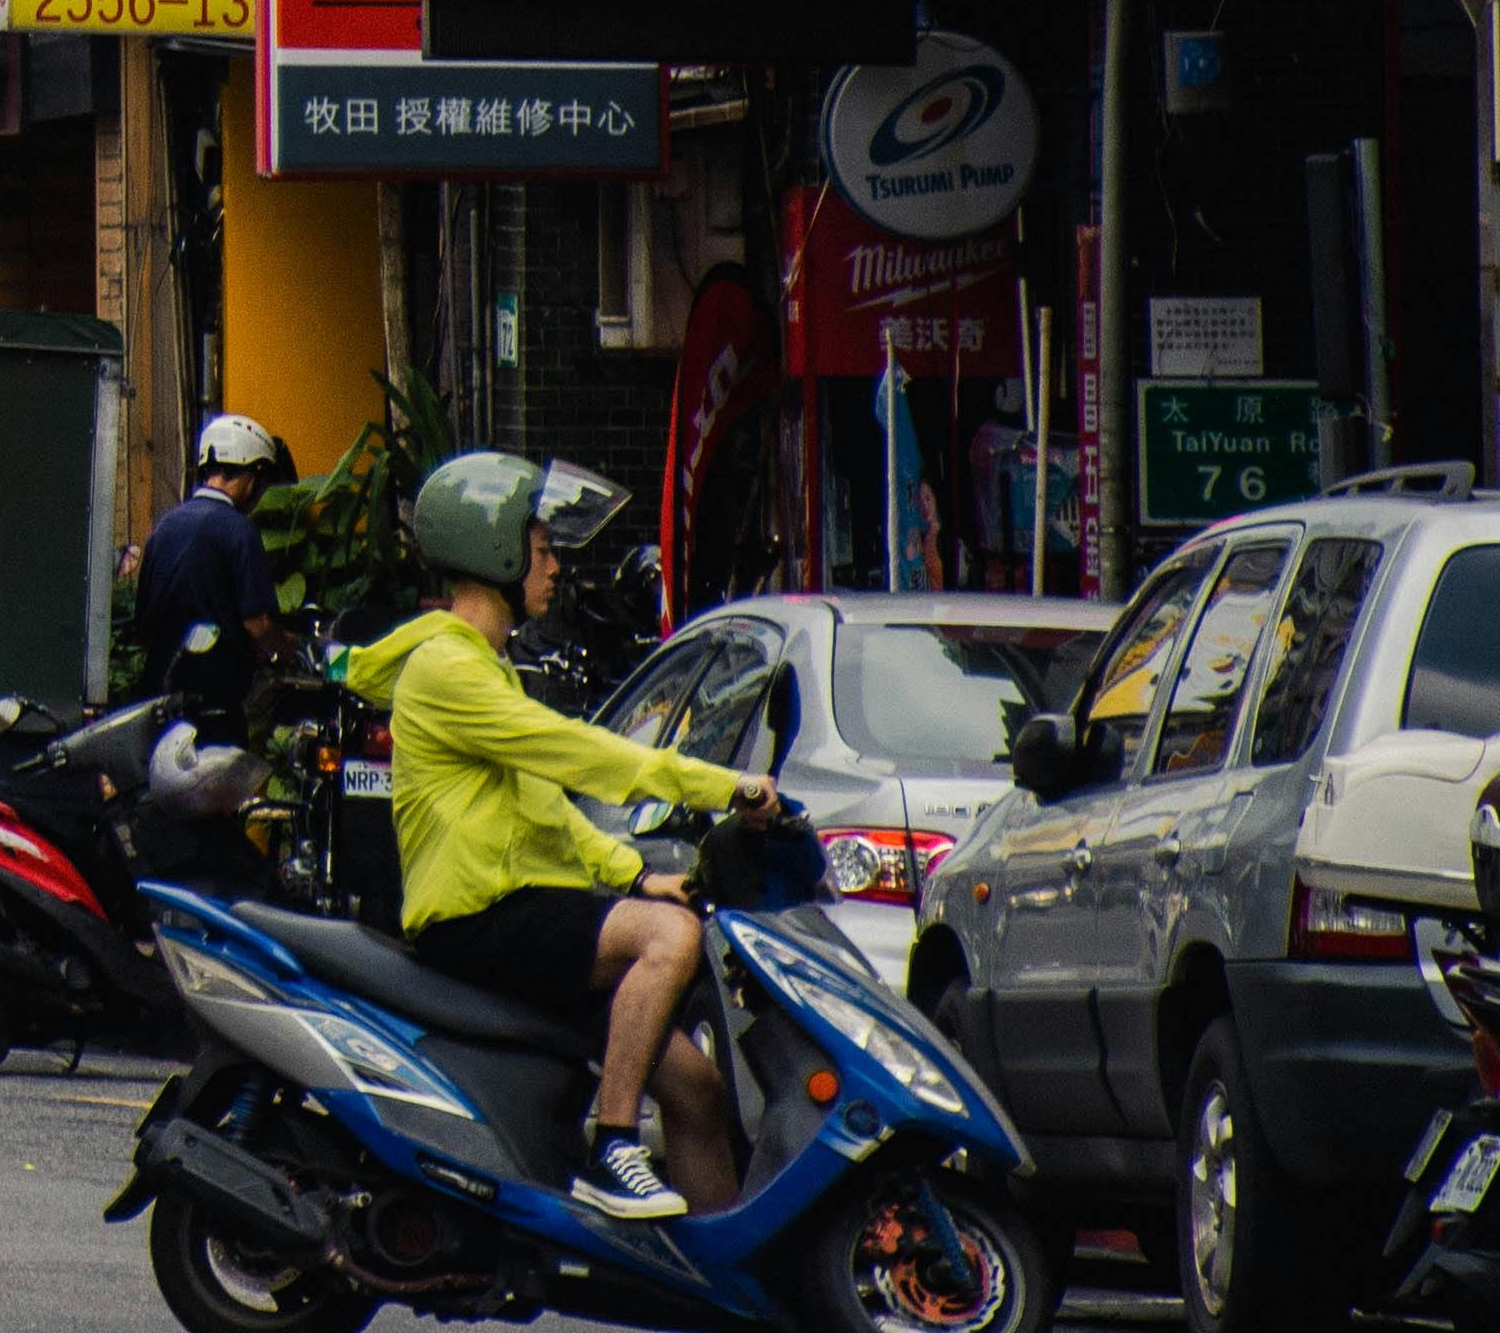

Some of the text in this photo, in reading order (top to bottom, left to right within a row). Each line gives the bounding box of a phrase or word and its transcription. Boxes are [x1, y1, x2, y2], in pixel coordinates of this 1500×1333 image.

[304, 96, 636, 137] 牧田 授權維修中心
[864, 161, 1016, 202] TSURUMI PUMP
[1171, 430, 1271, 454] TaiYuan
